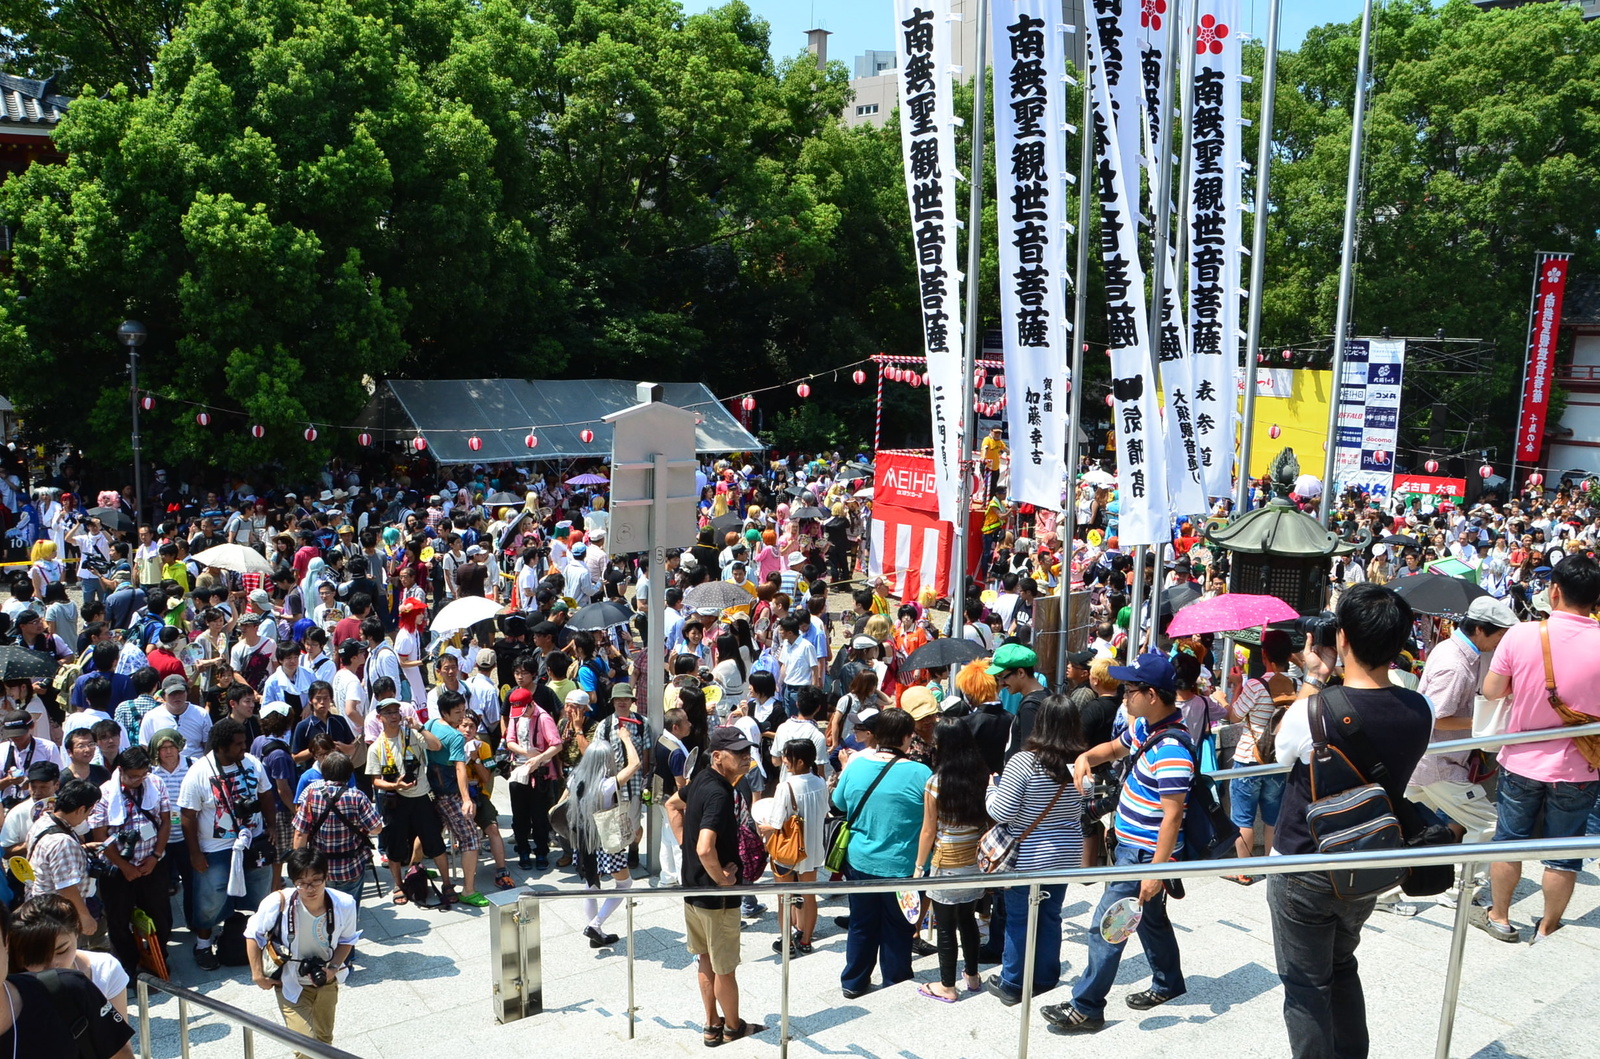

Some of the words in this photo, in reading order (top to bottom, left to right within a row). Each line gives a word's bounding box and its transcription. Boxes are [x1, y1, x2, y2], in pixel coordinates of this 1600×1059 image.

[902, 8, 949, 353] 南無聖観世音菩薩
[1007, 13, 1050, 348] 南無聖観世音菩薩
[1191, 66, 1225, 355] 南無聖観世音菩薩
[1375, 392, 1397, 400] コメ兵
[1025, 386, 1043, 465] 加藤幸吉
[1365, 435, 1392, 443] docomo
[882, 467, 937, 494] MEIHO
[1402, 481, 1430, 493] 名古屋
[11, 538, 23, 549] 10
